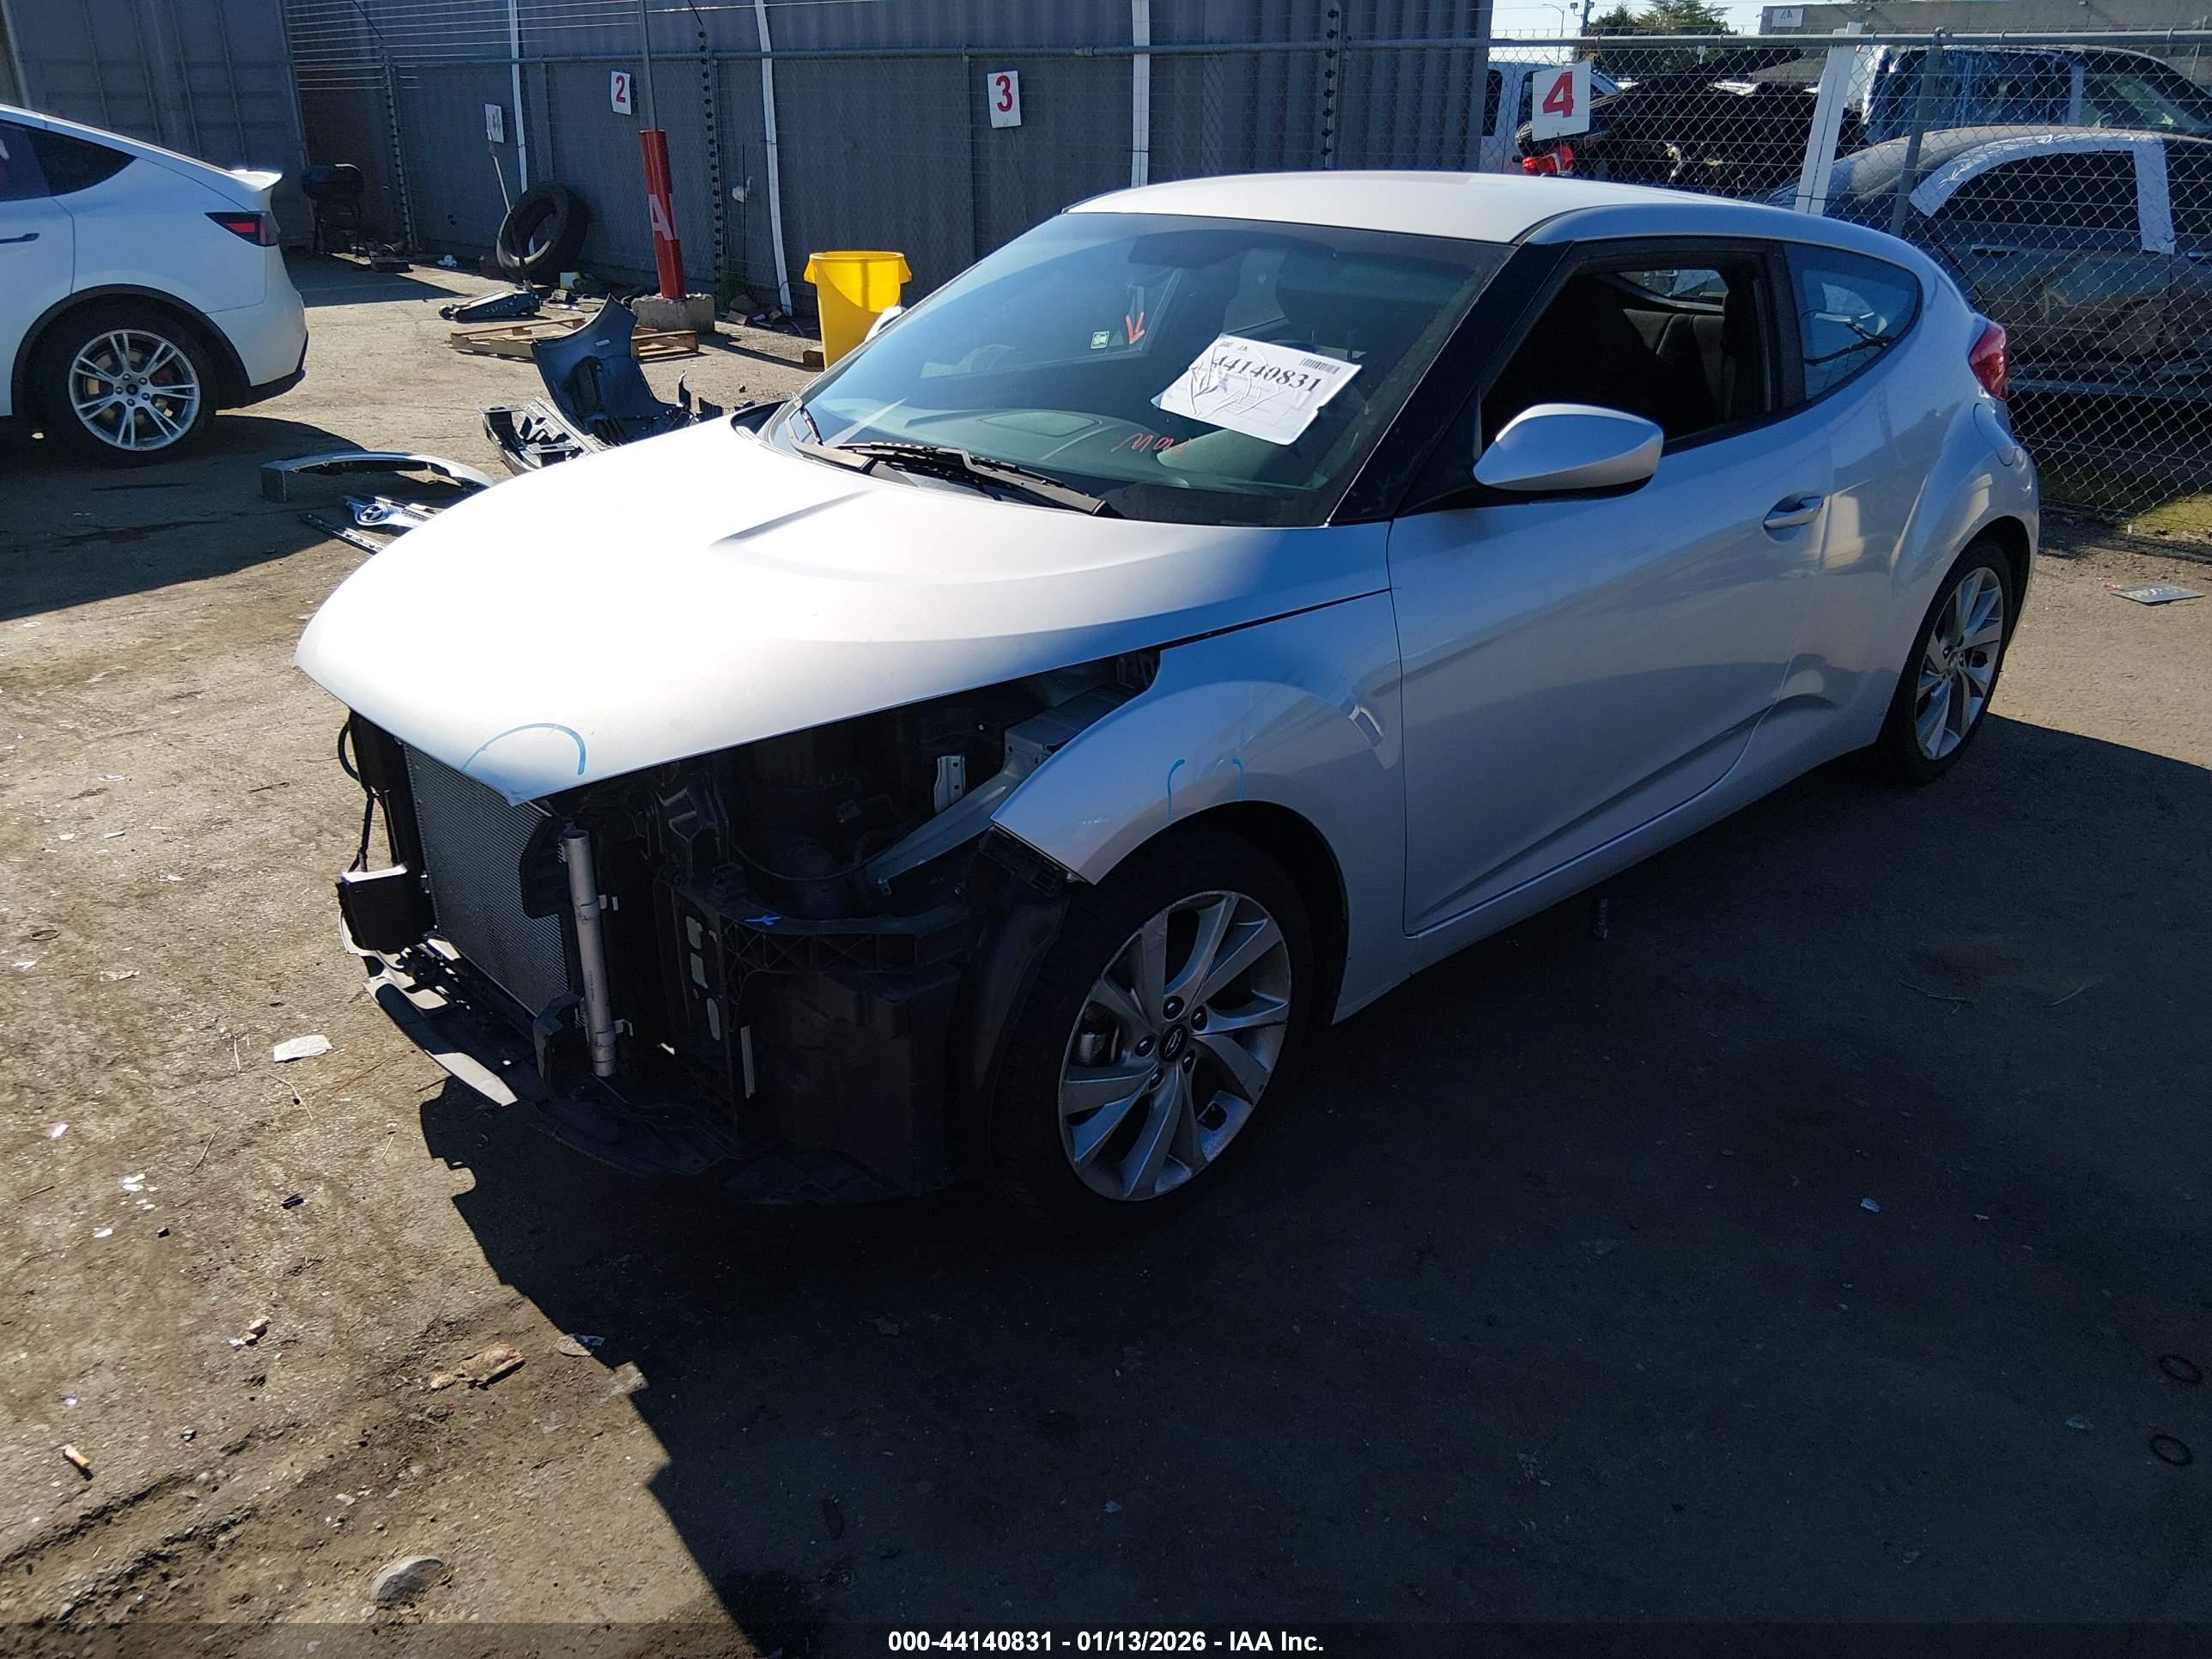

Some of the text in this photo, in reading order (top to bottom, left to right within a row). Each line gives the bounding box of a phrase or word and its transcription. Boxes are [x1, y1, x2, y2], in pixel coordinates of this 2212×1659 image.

[616, 75, 627, 103] 2
[996, 75, 1013, 112] 3
[1542, 70, 1573, 118] 4
[1211, 356, 1322, 392] 44140831
